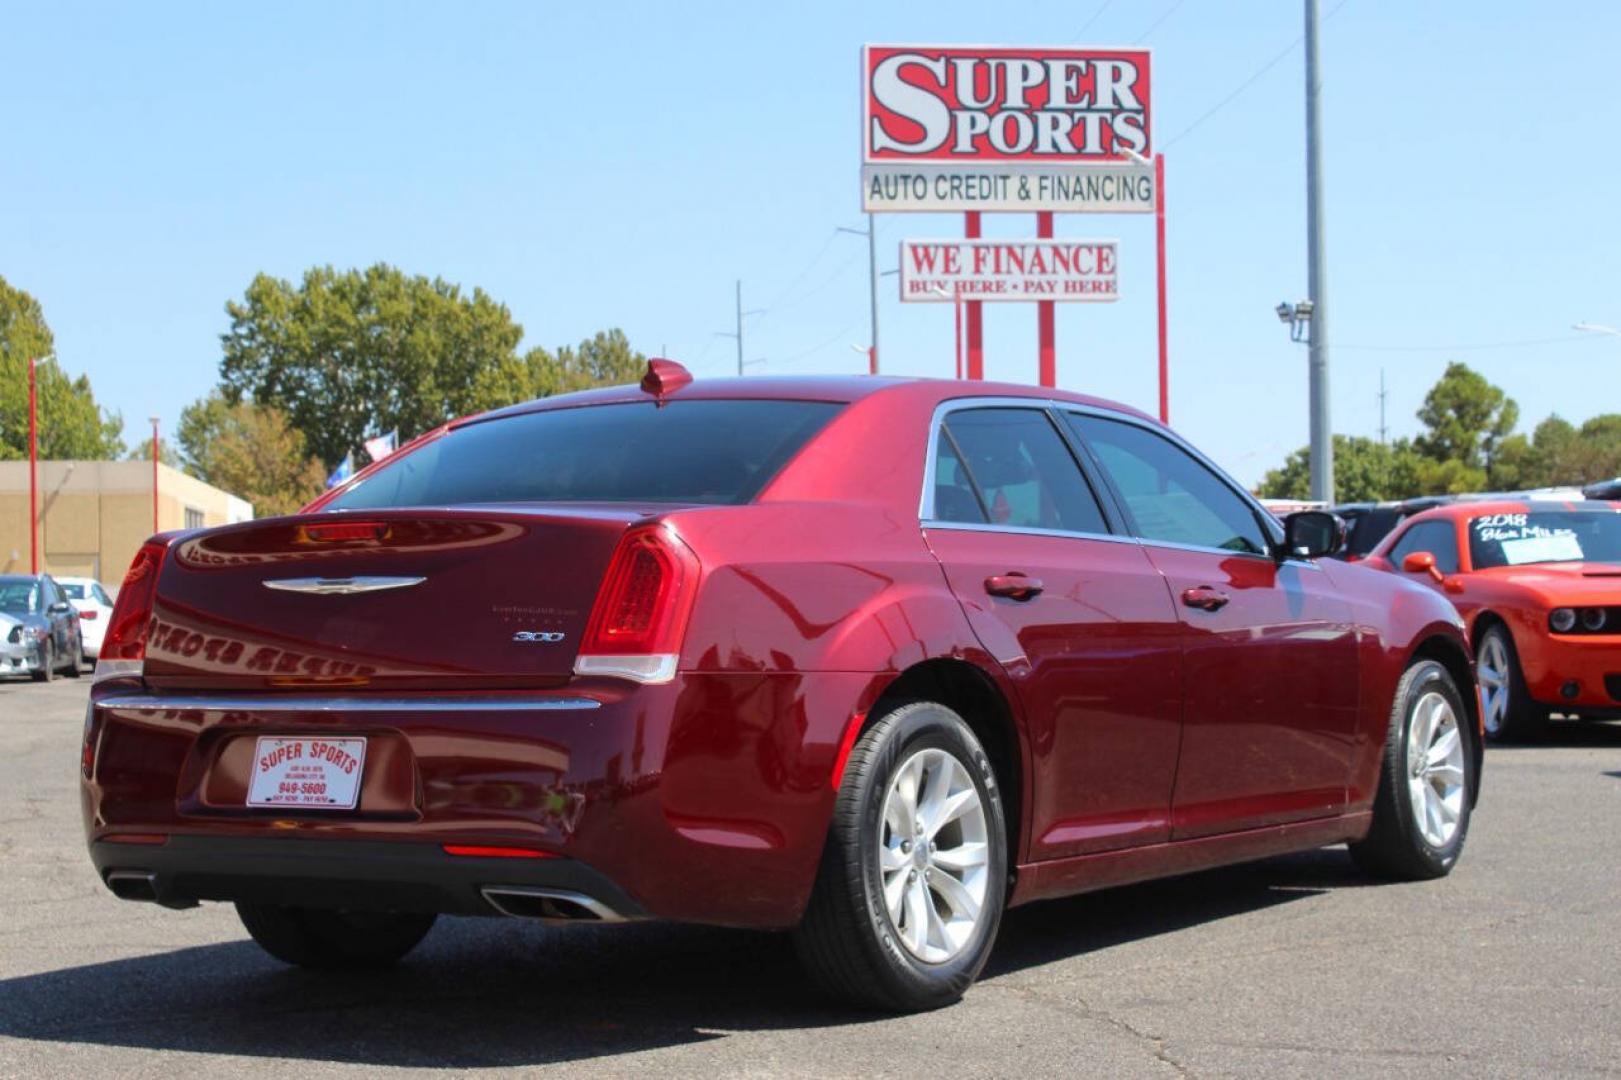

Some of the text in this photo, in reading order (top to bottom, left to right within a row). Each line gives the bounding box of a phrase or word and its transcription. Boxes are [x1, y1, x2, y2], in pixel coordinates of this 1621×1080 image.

[869, 174, 1151, 202] AUTO CREDIT & FINANCING
[909, 244, 1116, 275] WE FINANCE
[909, 280, 1117, 293] BUY HERE PAY HERE
[1476, 513, 1528, 530] 2018
[512, 631, 565, 641] 300
[260, 742, 357, 774] SUPER SPORTS
[278, 782, 327, 794] 949-5600
